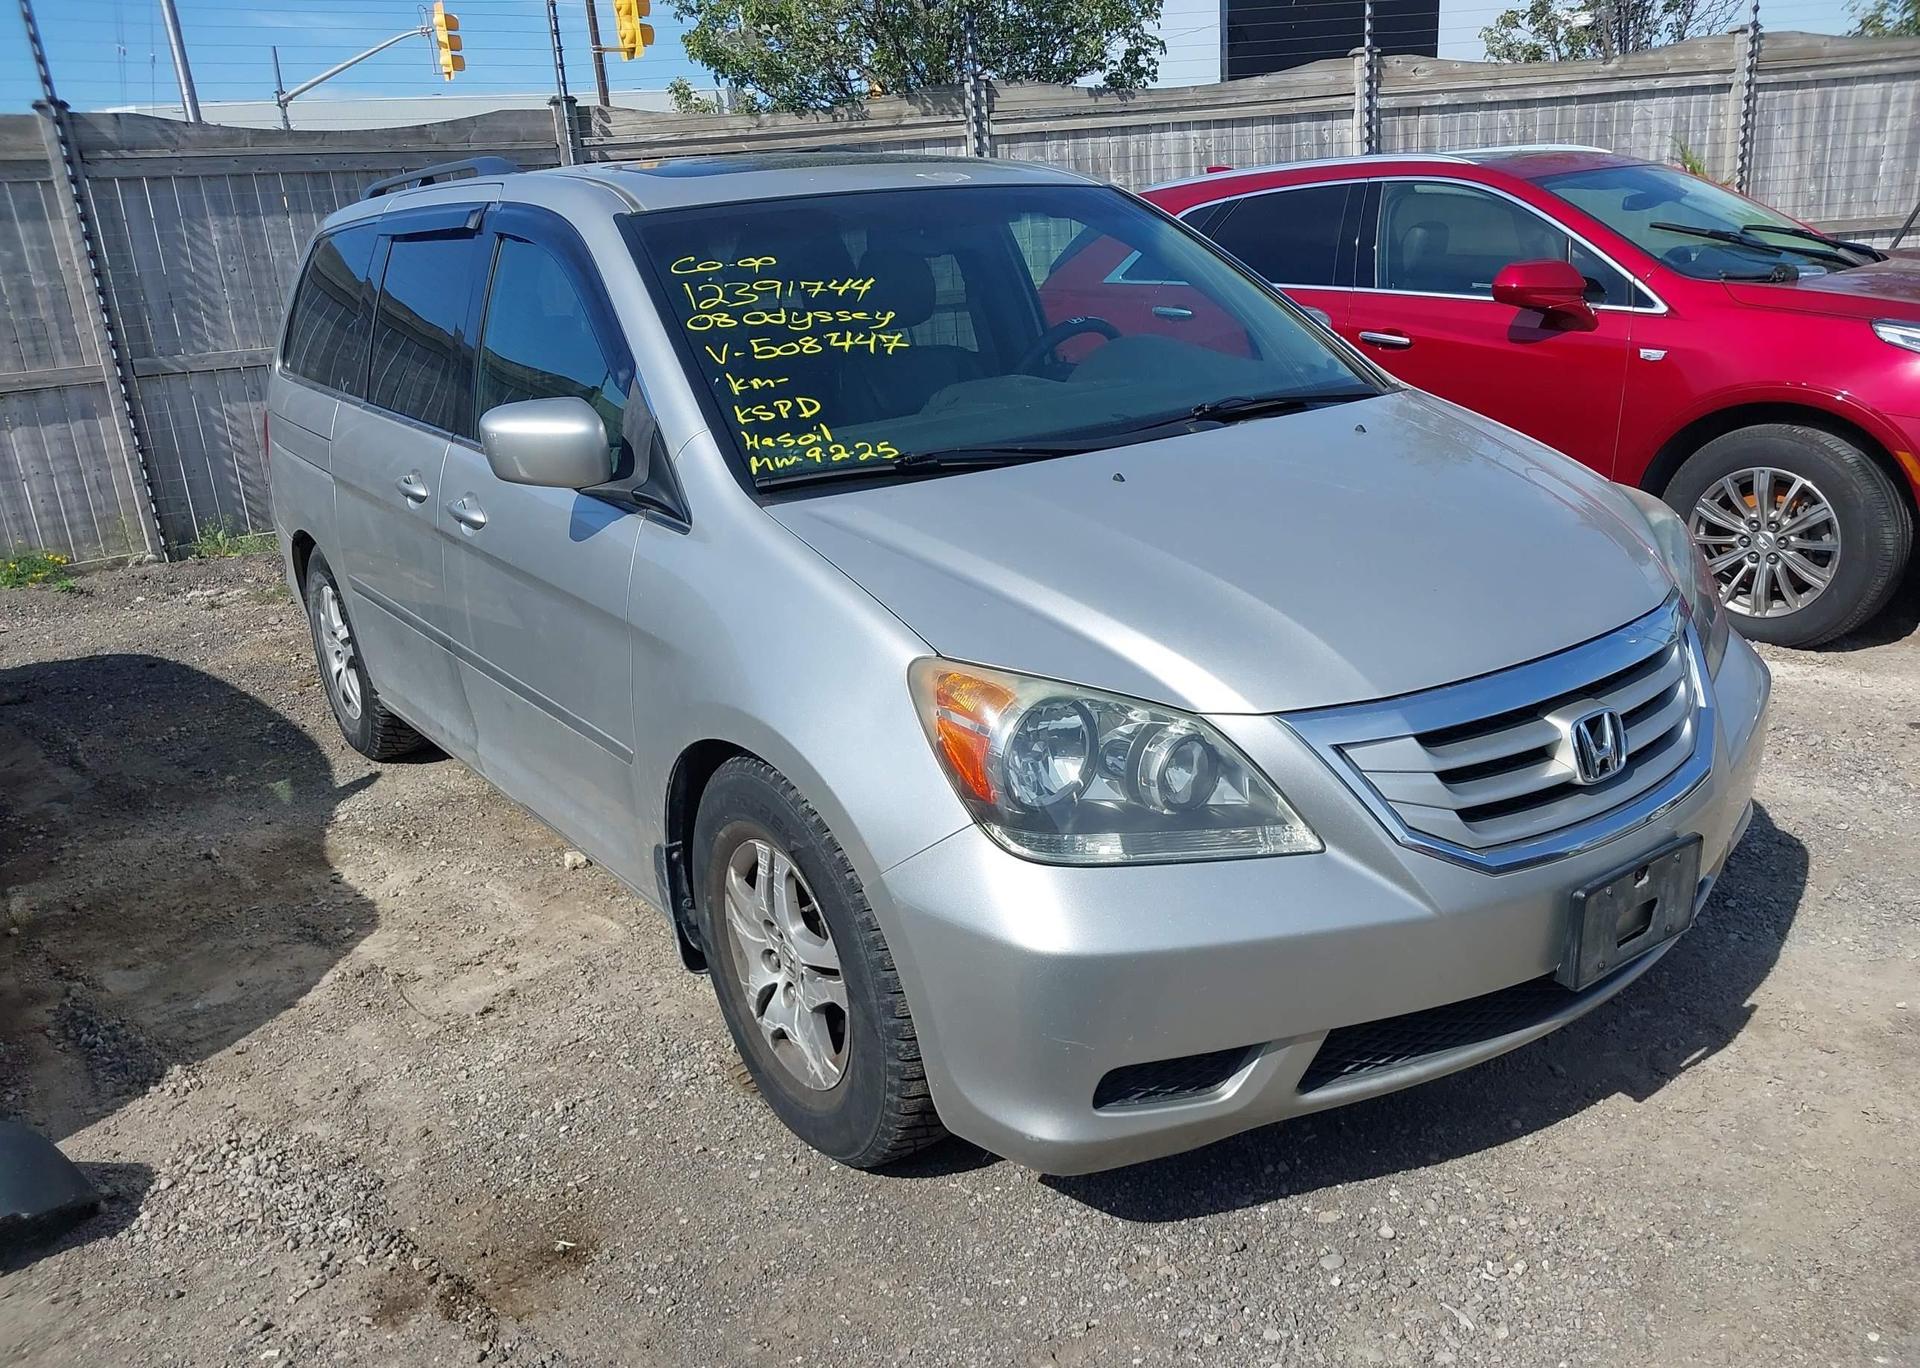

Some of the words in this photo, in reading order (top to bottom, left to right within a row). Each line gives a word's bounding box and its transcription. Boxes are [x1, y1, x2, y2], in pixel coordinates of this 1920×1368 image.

[682, 277, 876, 311] 12391744
[686, 313, 738, 331] 08
[734, 397, 821, 424] KSPD
